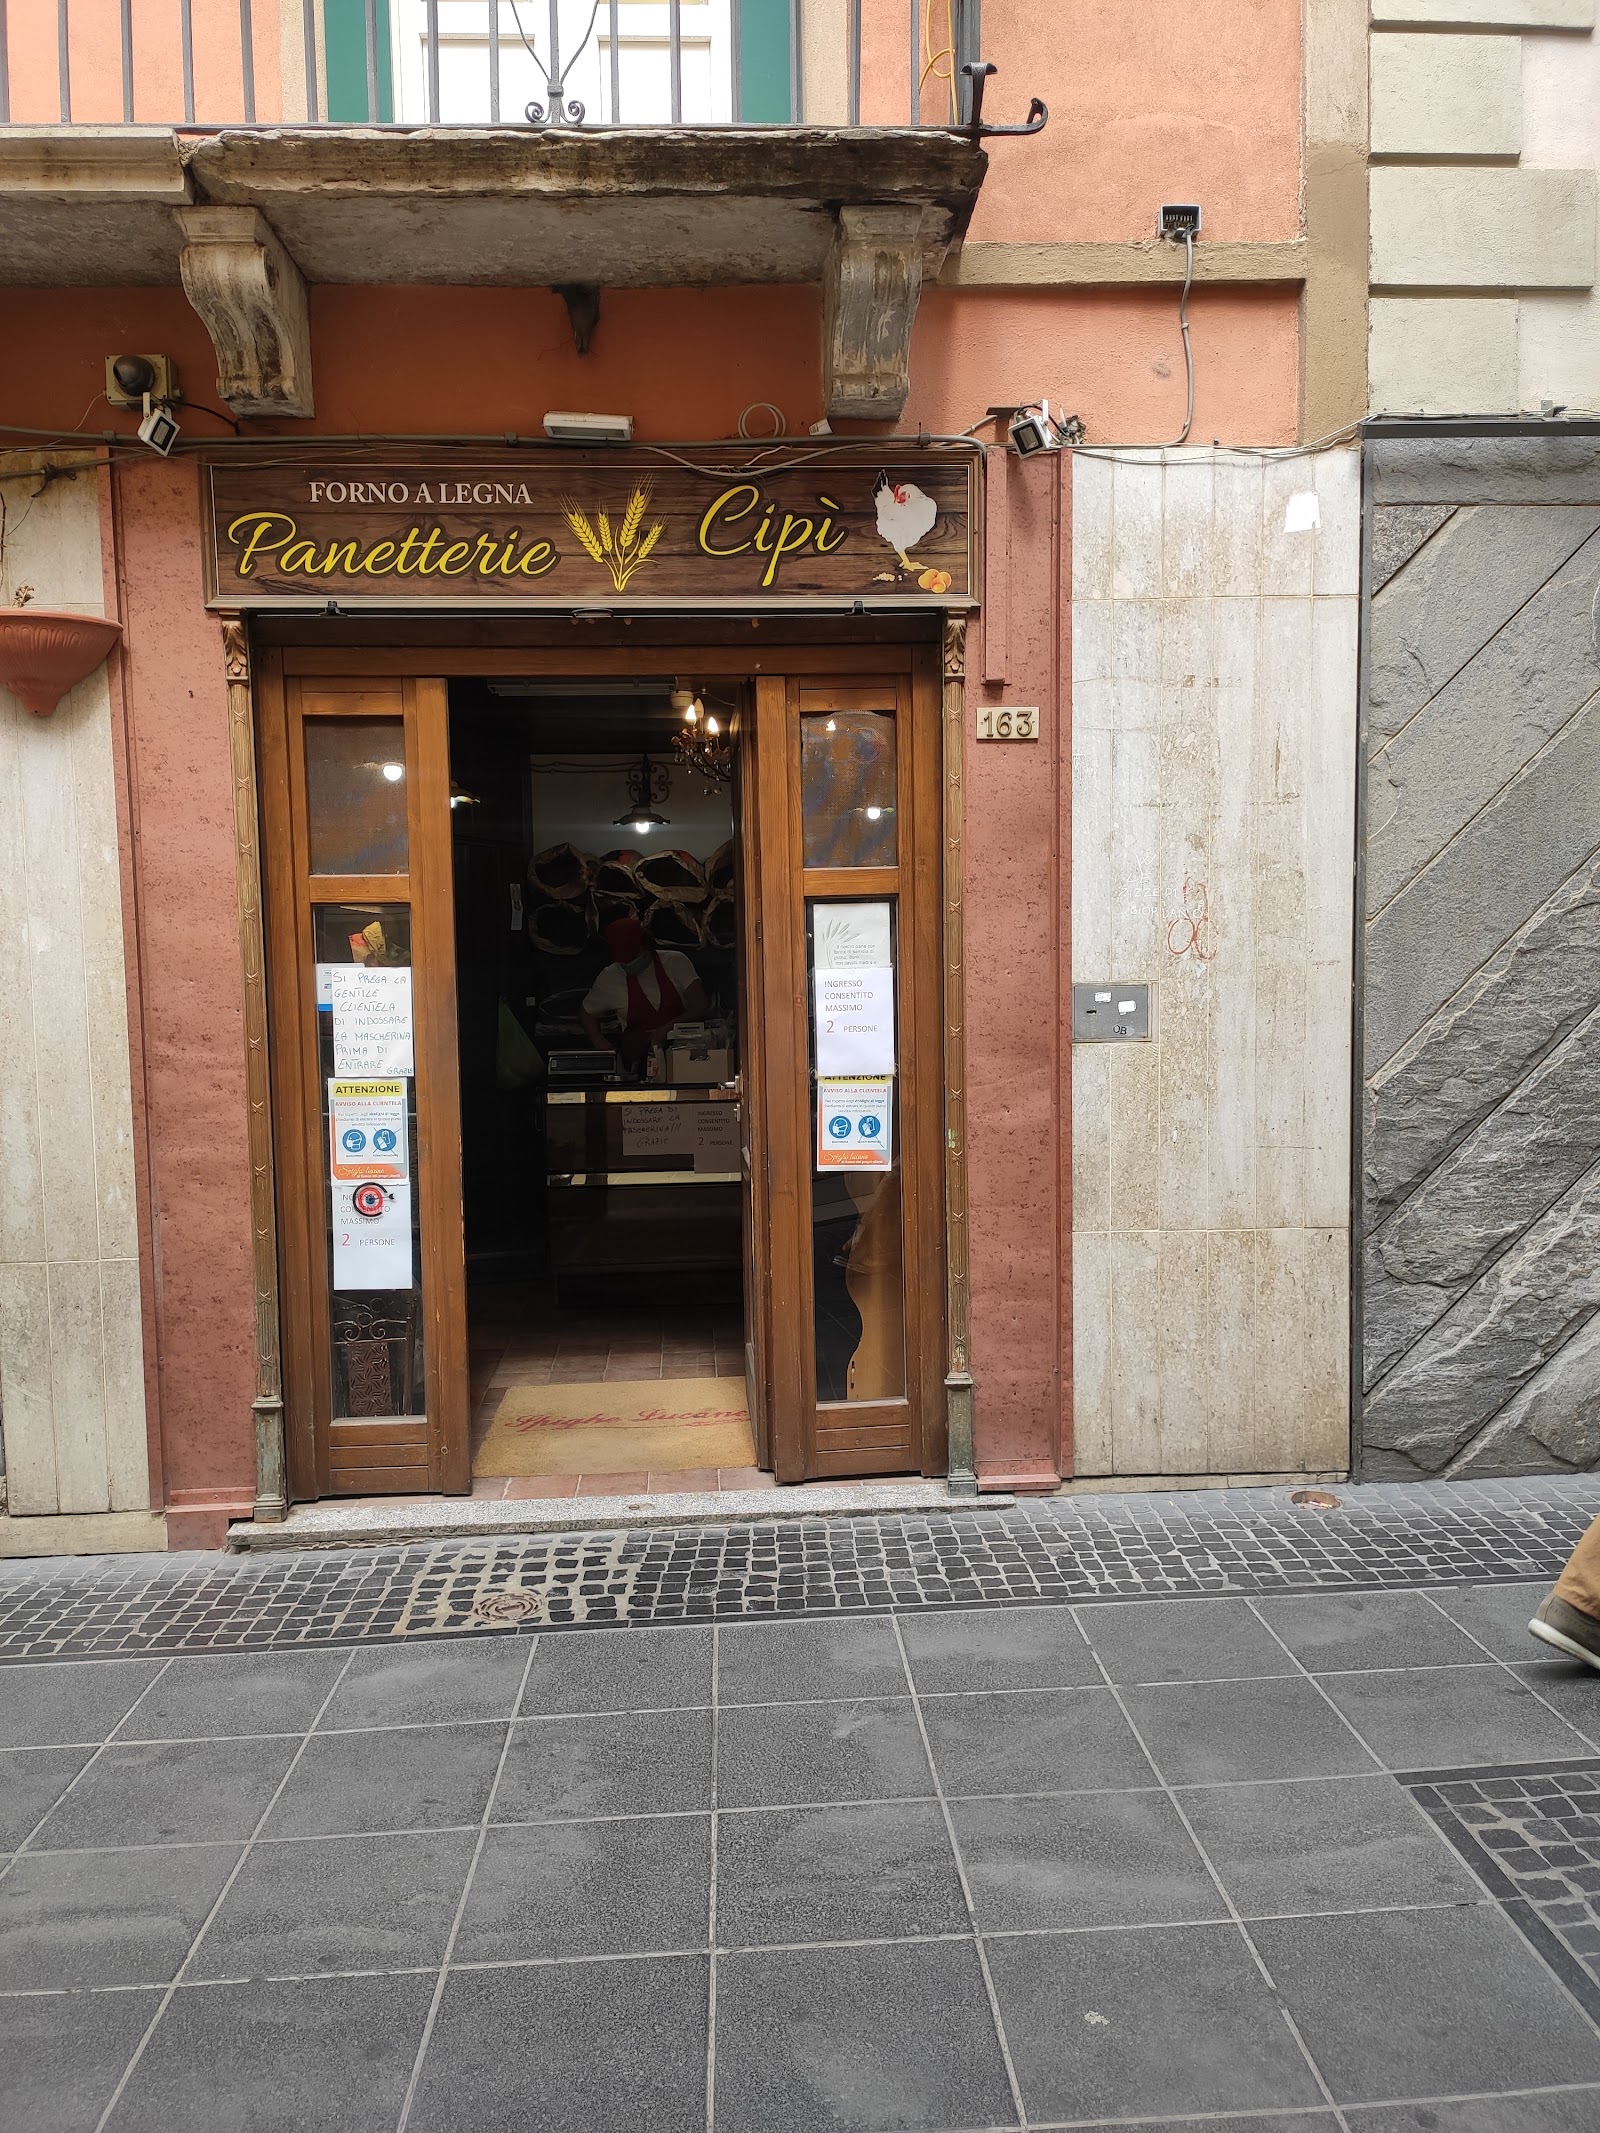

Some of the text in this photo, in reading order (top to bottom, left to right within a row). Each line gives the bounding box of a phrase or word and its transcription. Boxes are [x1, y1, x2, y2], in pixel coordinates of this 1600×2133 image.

[309, 482, 533, 504] FORNO A LEGNA
[699, 485, 845, 586] Cipì
[228, 512, 556, 575] Panetterie
[983, 711, 1032, 737] 163
[333, 972, 346, 983] SI
[358, 973, 387, 984] PREGA
[394, 976, 407, 985] LA
[824, 980, 863, 988] INGRESSO
[335, 987, 380, 998] GENTILE
[824, 992, 874, 1000] CONSENTITO
[340, 1001, 396, 1012] CLIENTELA
[825, 1004, 863, 1012] MASSIMO
[335, 1016, 408, 1026] DI INDOSSARE
[826, 1020, 878, 1033] 2 PERSONE
[335, 1031, 411, 1042] LA MASCHERINA
[336, 1044, 388, 1055] PRIMA DI
[338, 1059, 384, 1070] ENTRARE
[335, 1085, 400, 1094] ATTENZIONE
[639, 1106, 663, 1115] PREGA
[623, 1117, 663, 1125] INDOSSARE
[698, 1136, 704, 1146] 2
[340, 1217, 380, 1225] MASSIMO
[342, 1233, 350, 1247] 2
